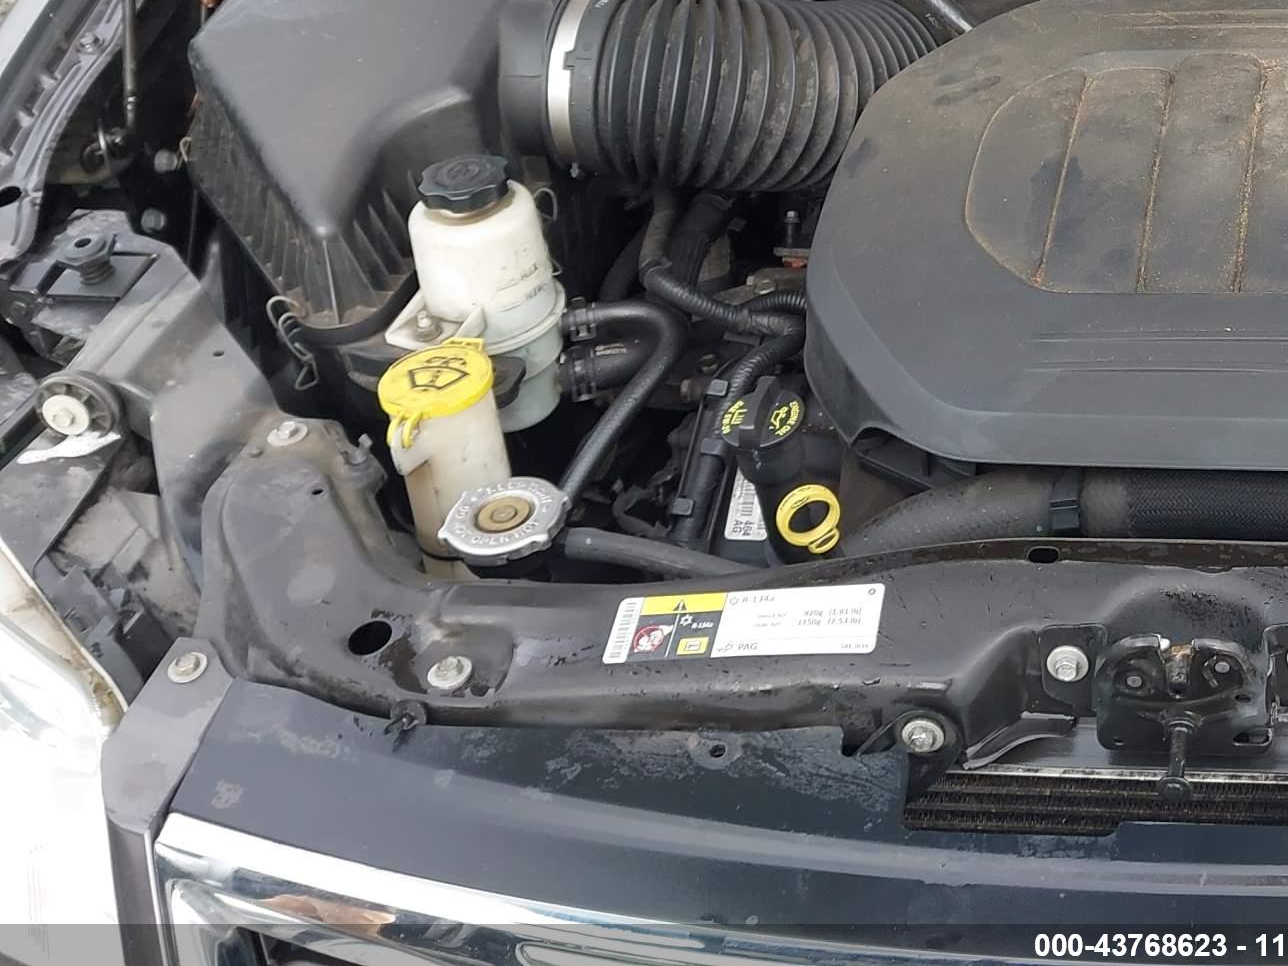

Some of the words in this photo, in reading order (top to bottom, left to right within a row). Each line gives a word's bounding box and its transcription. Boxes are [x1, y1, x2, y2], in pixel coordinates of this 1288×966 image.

[786, 400, 801, 426] ENGINE
[775, 422, 791, 436] OIL
[736, 642, 758, 651] PAG
